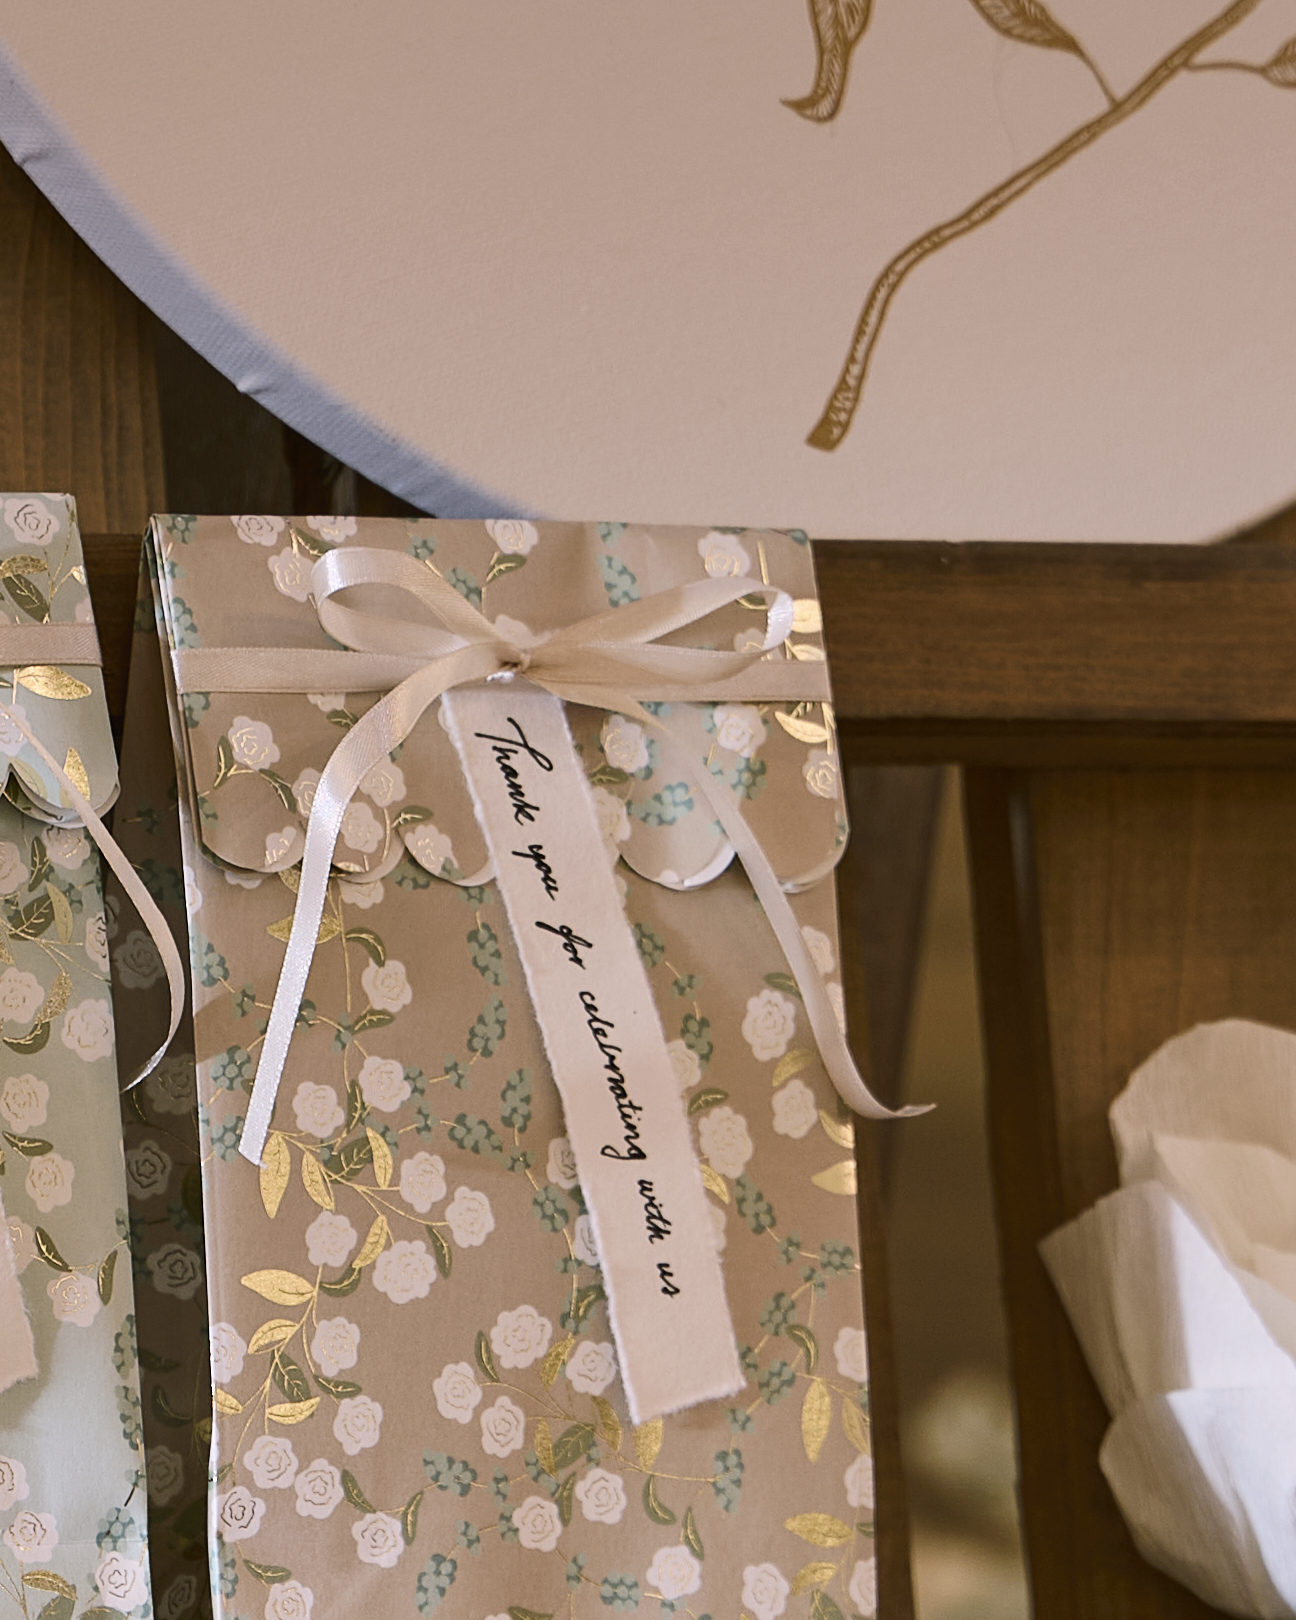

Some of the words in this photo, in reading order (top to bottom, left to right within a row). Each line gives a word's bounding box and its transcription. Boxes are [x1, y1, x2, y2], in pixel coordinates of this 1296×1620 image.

[474, 716, 554, 826] Thank
[511, 844, 559, 901] you
[534, 920, 594, 970] for
[578, 991, 647, 1161] celebrating
[637, 1179, 665, 1245] with
[656, 1262, 681, 1298] us
